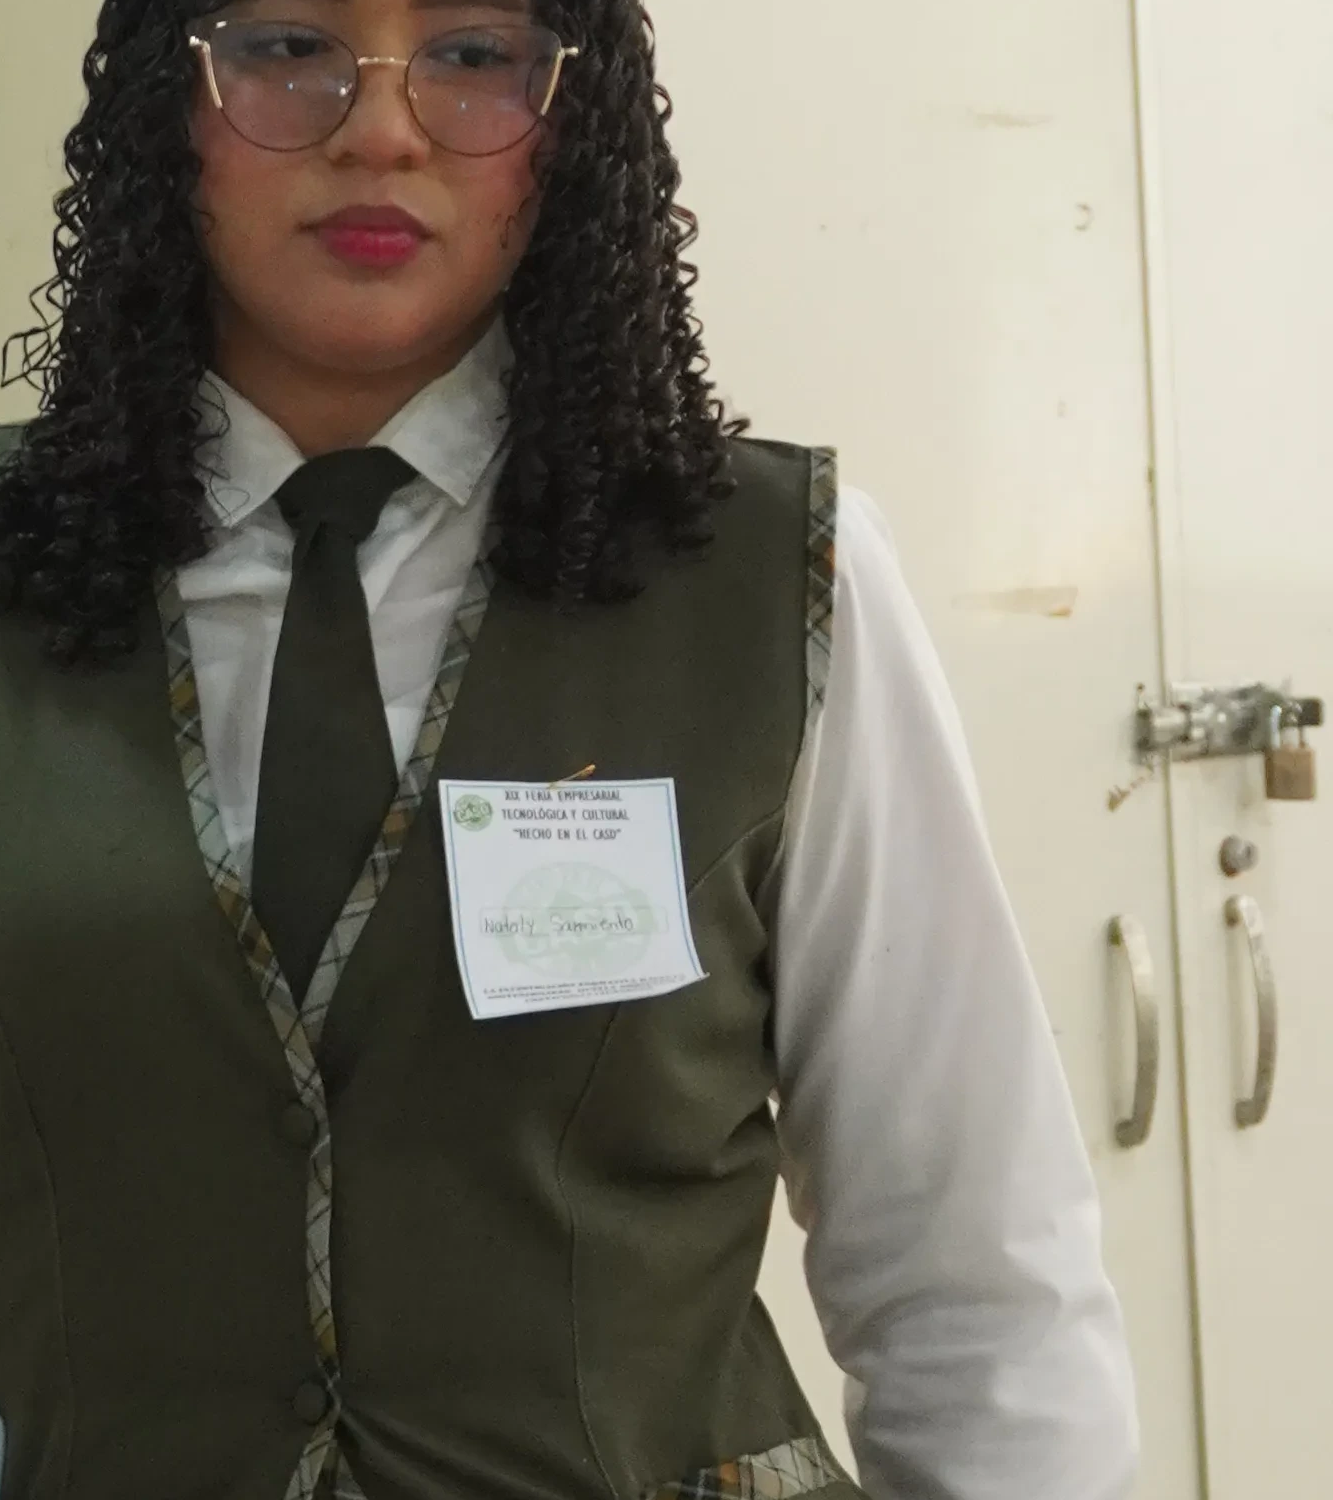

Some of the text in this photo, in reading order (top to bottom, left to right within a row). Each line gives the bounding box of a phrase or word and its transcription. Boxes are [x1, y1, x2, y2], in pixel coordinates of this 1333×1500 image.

[504, 789, 622, 802] XIX FERIA EMPRESARIAL
[501, 806, 630, 821] TECNOLÓGICA Y CULTURAL
[557, 828, 570, 840] EN
[576, 828, 588, 840] EL
